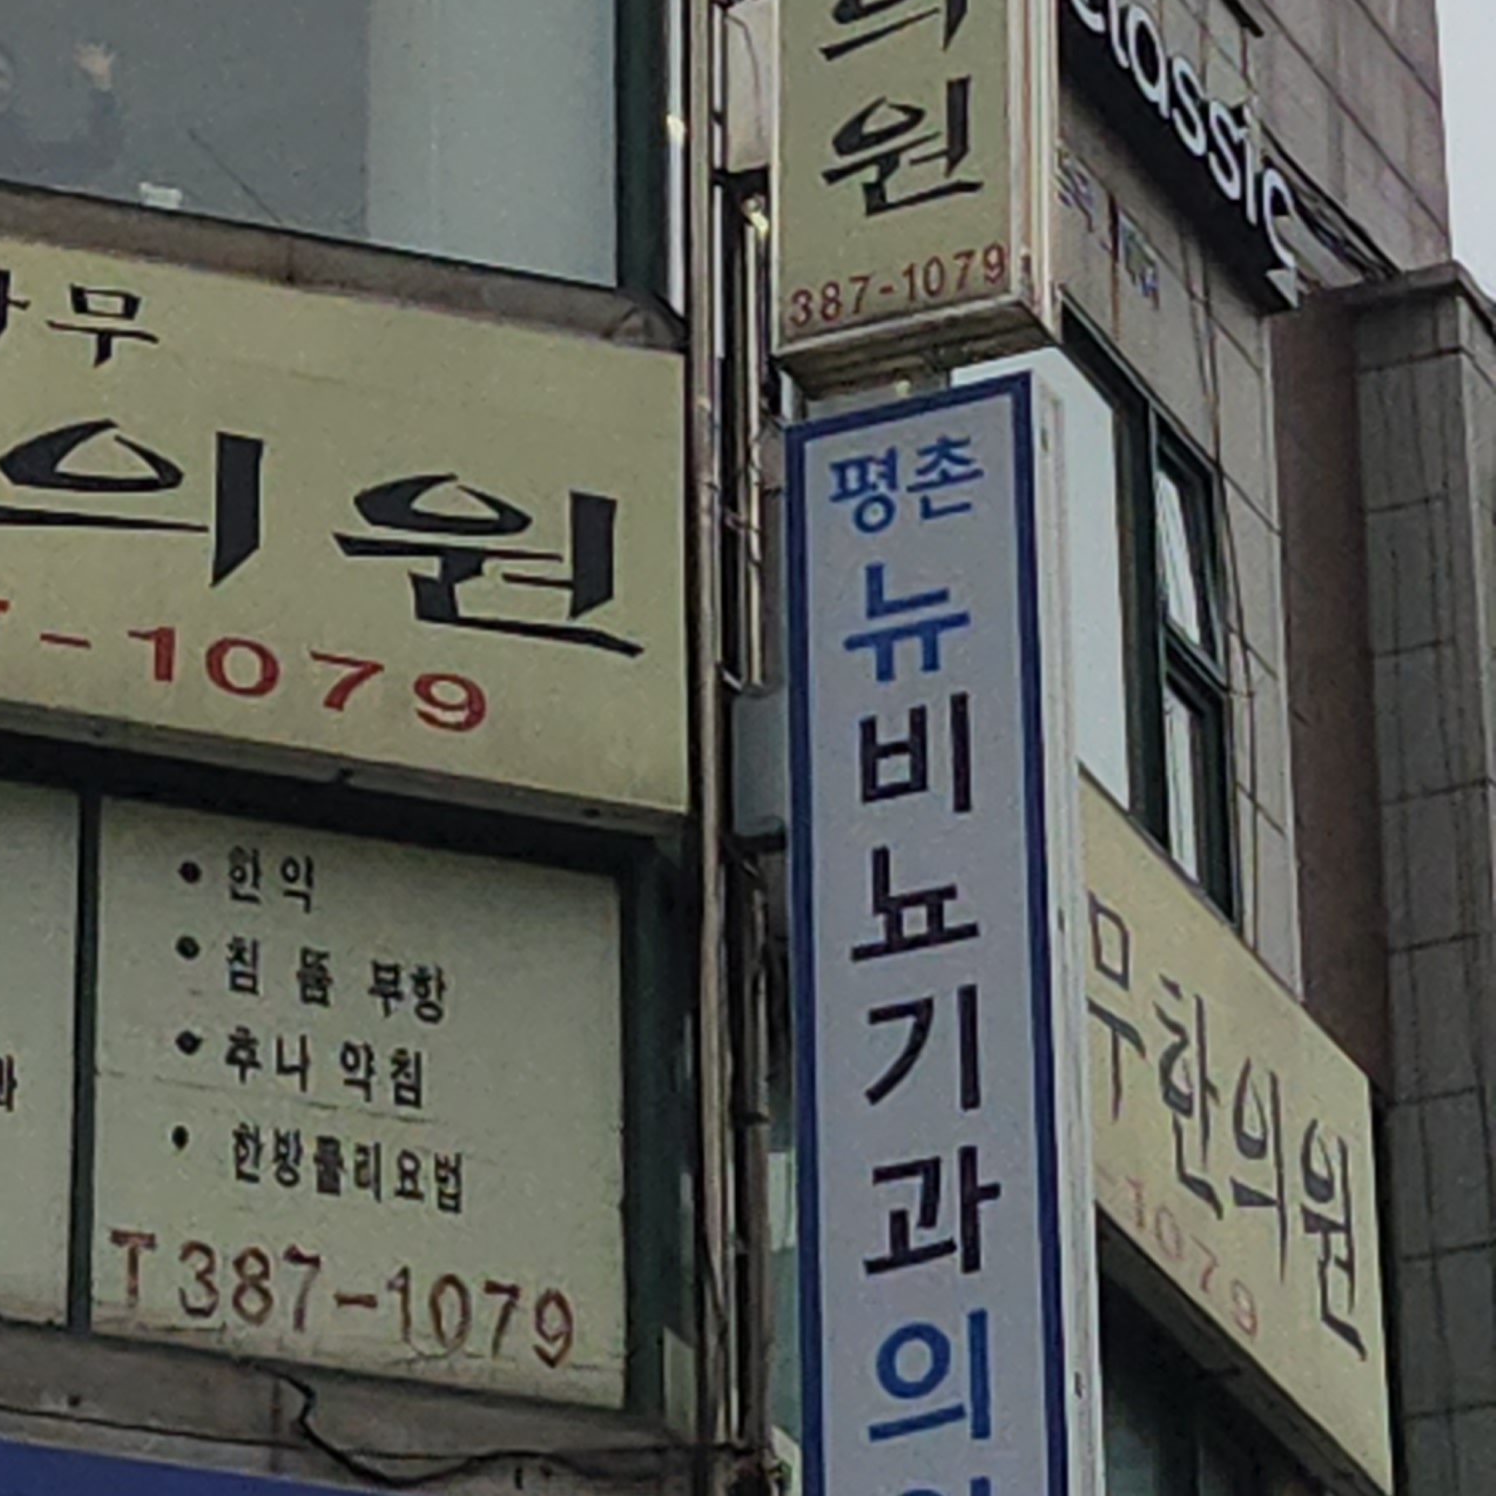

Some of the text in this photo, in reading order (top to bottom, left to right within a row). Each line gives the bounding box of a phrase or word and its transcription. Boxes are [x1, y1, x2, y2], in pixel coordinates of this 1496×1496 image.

[789, 242, 1007, 328] 387-1079
[829, 434, 985, 534] 평촌
[226, 936, 260, 996] 침
[368, 958, 447, 1025] 부항
[224, 1026, 423, 1108] 추나 약침
[844, 561, 1001, 1496] 뉴비뇨기과의
[231, 1122, 462, 1215] 한방물리요법
